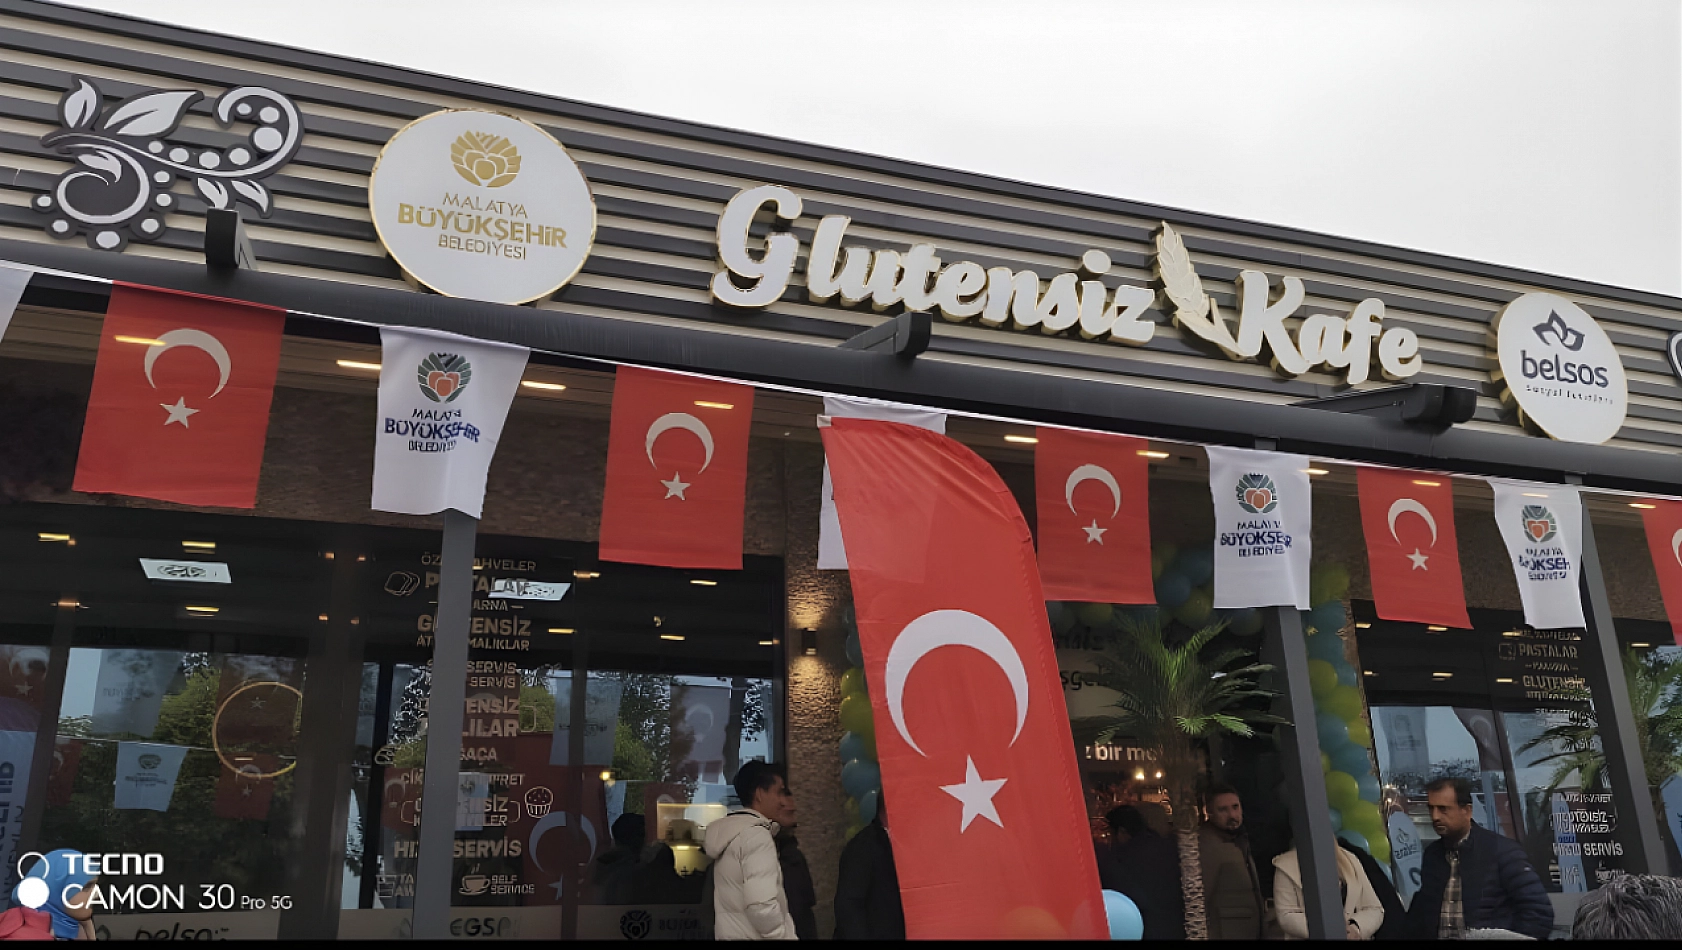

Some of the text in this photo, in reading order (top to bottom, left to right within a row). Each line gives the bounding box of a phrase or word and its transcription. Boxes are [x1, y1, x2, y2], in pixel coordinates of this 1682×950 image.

[443, 192, 528, 219] MALATYA
[398, 203, 567, 248] BÜYÜKŞEHİR
[711, 184, 1156, 344] Glutensiz
[1236, 269, 1423, 386] Kafe
[1521, 350, 1609, 388] belsos
[473, 558, 537, 571] AHVELER
[1095, 741, 1122, 760] bir
